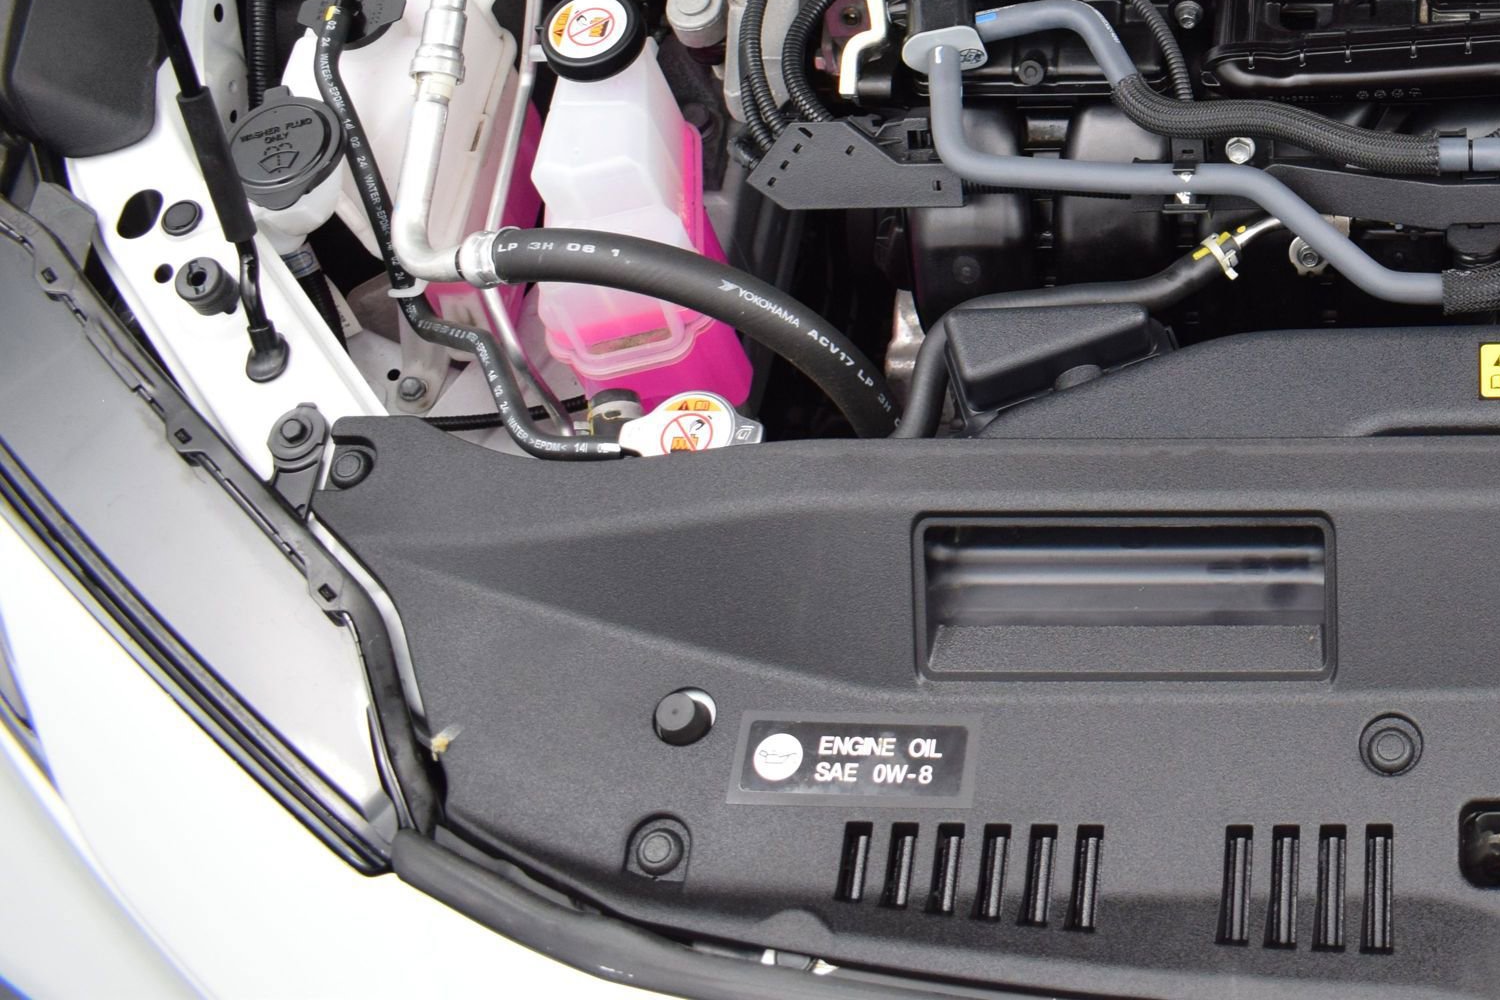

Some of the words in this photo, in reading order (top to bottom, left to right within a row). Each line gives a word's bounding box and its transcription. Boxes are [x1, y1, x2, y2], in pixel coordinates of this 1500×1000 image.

[325, 20, 337, 31] 02
[320, 37, 332, 48] 24
[319, 52, 334, 82] WATER
[240, 126, 281, 143] WASHER
[285, 117, 313, 131] FLUID
[264, 131, 289, 144] ONLY
[350, 137, 361, 149] 02
[364, 174, 382, 206] WATER
[497, 242, 519, 253] LP
[527, 241, 555, 251] 3H
[737, 287, 801, 329] YOKOHAMA
[807, 328, 857, 367] ACV17
[857, 368, 875, 388] LP
[506, 415, 529, 442] WATER
[818, 735, 897, 757] ENGINE
[907, 738, 943, 759] OIL
[813, 761, 859, 783] SAE
[871, 764, 934, 785] 0W-8
